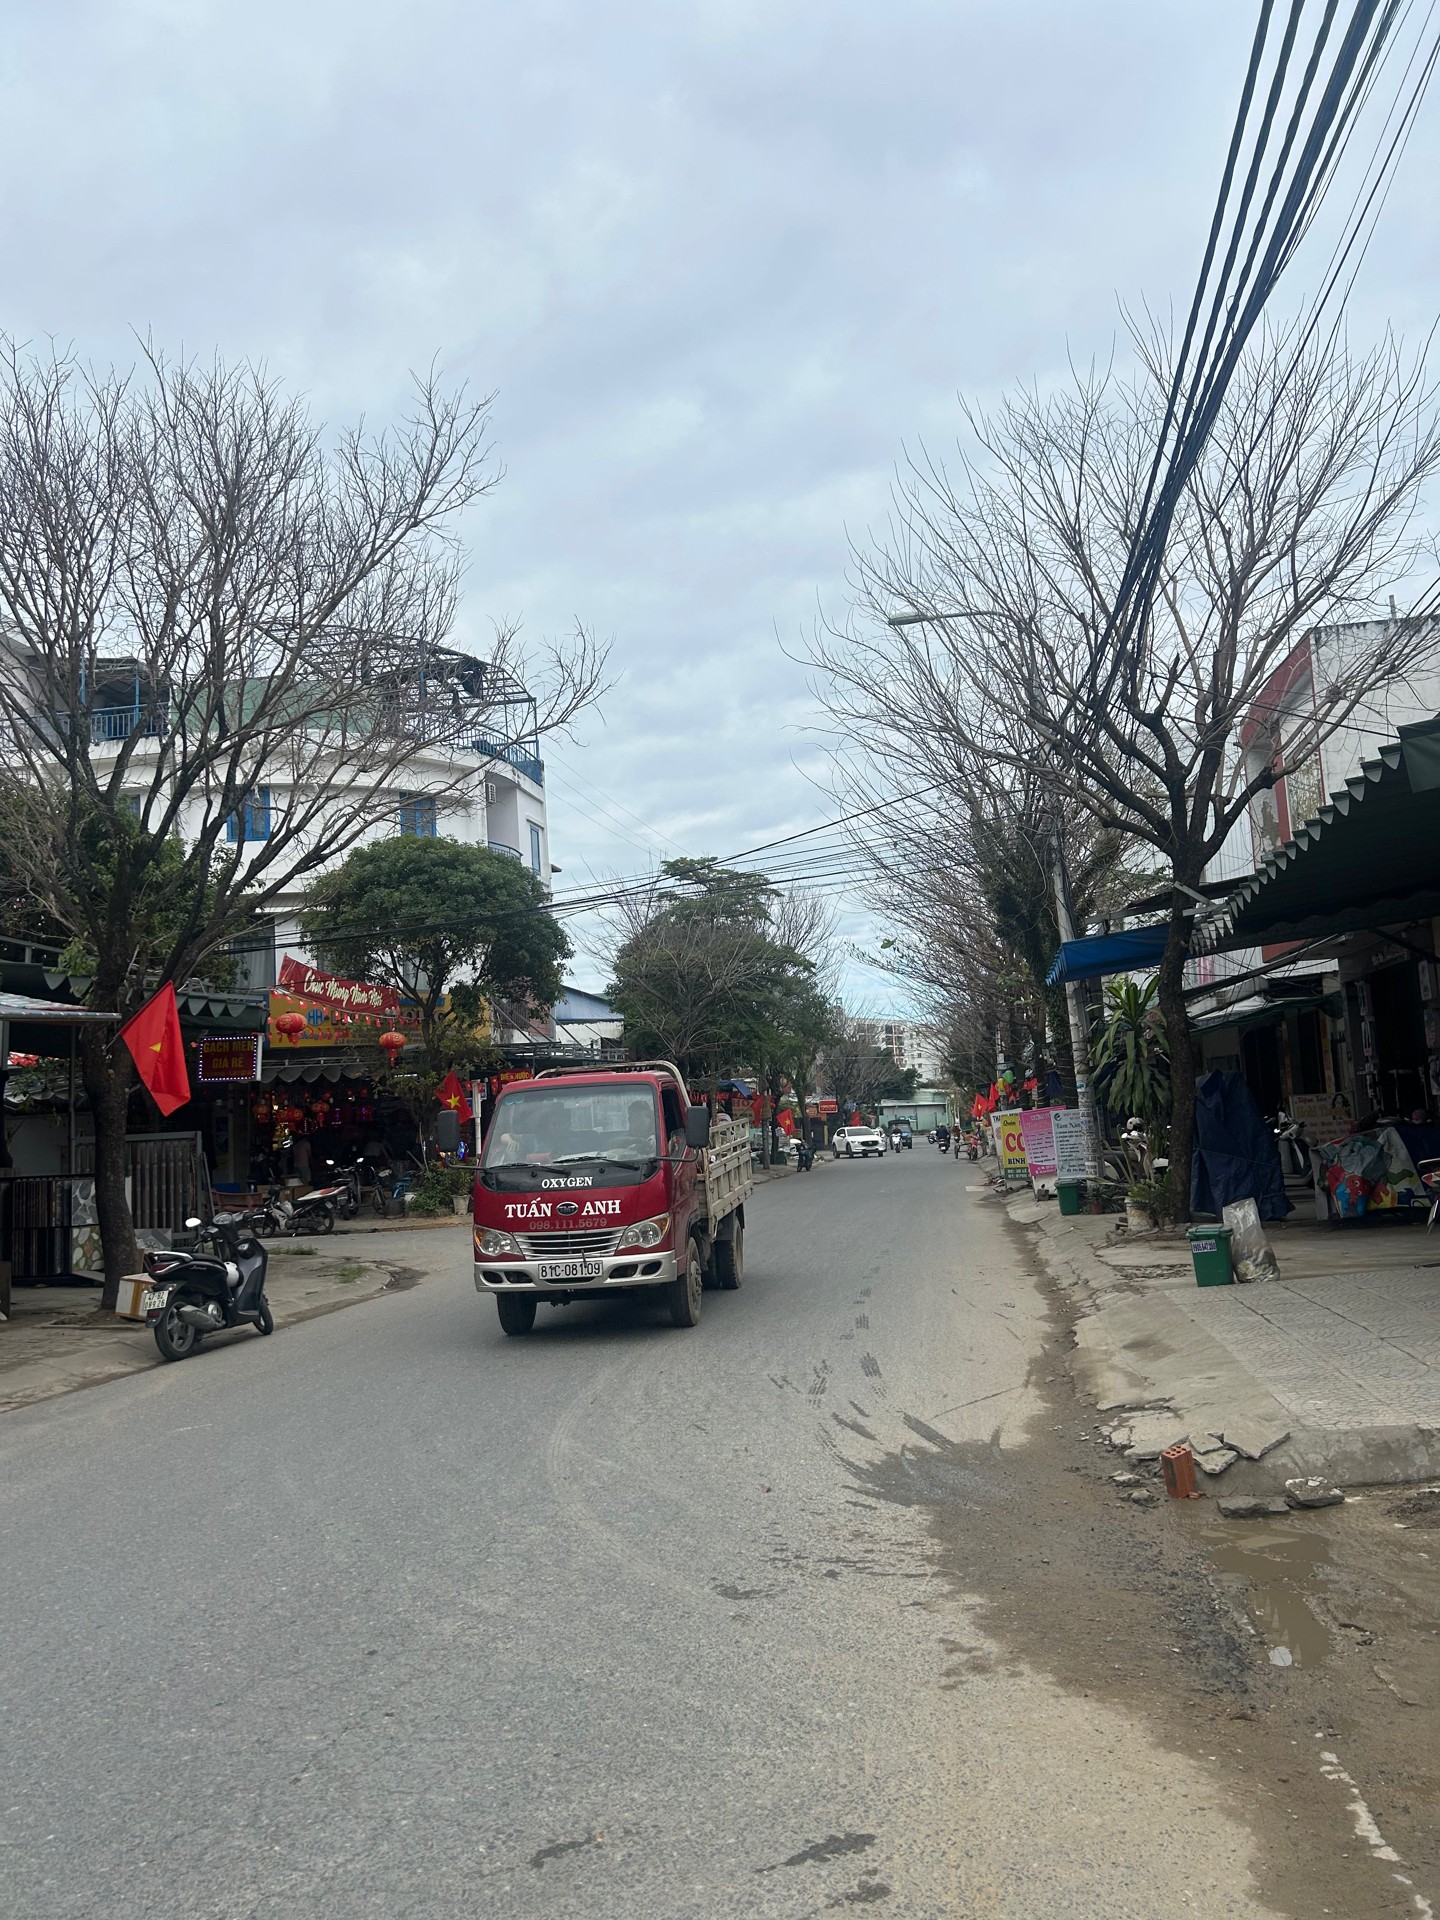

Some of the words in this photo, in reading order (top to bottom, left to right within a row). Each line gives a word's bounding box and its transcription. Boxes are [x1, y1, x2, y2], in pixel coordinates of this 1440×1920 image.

[542, 1176, 593, 1189] OXYGEN
[505, 1197, 552, 1218] TUẤN
[581, 1200, 621, 1215] ANH
[529, 1217, 607, 1230] 098.111.5679
[540, 1263, 601, 1278] 81C-081.09
